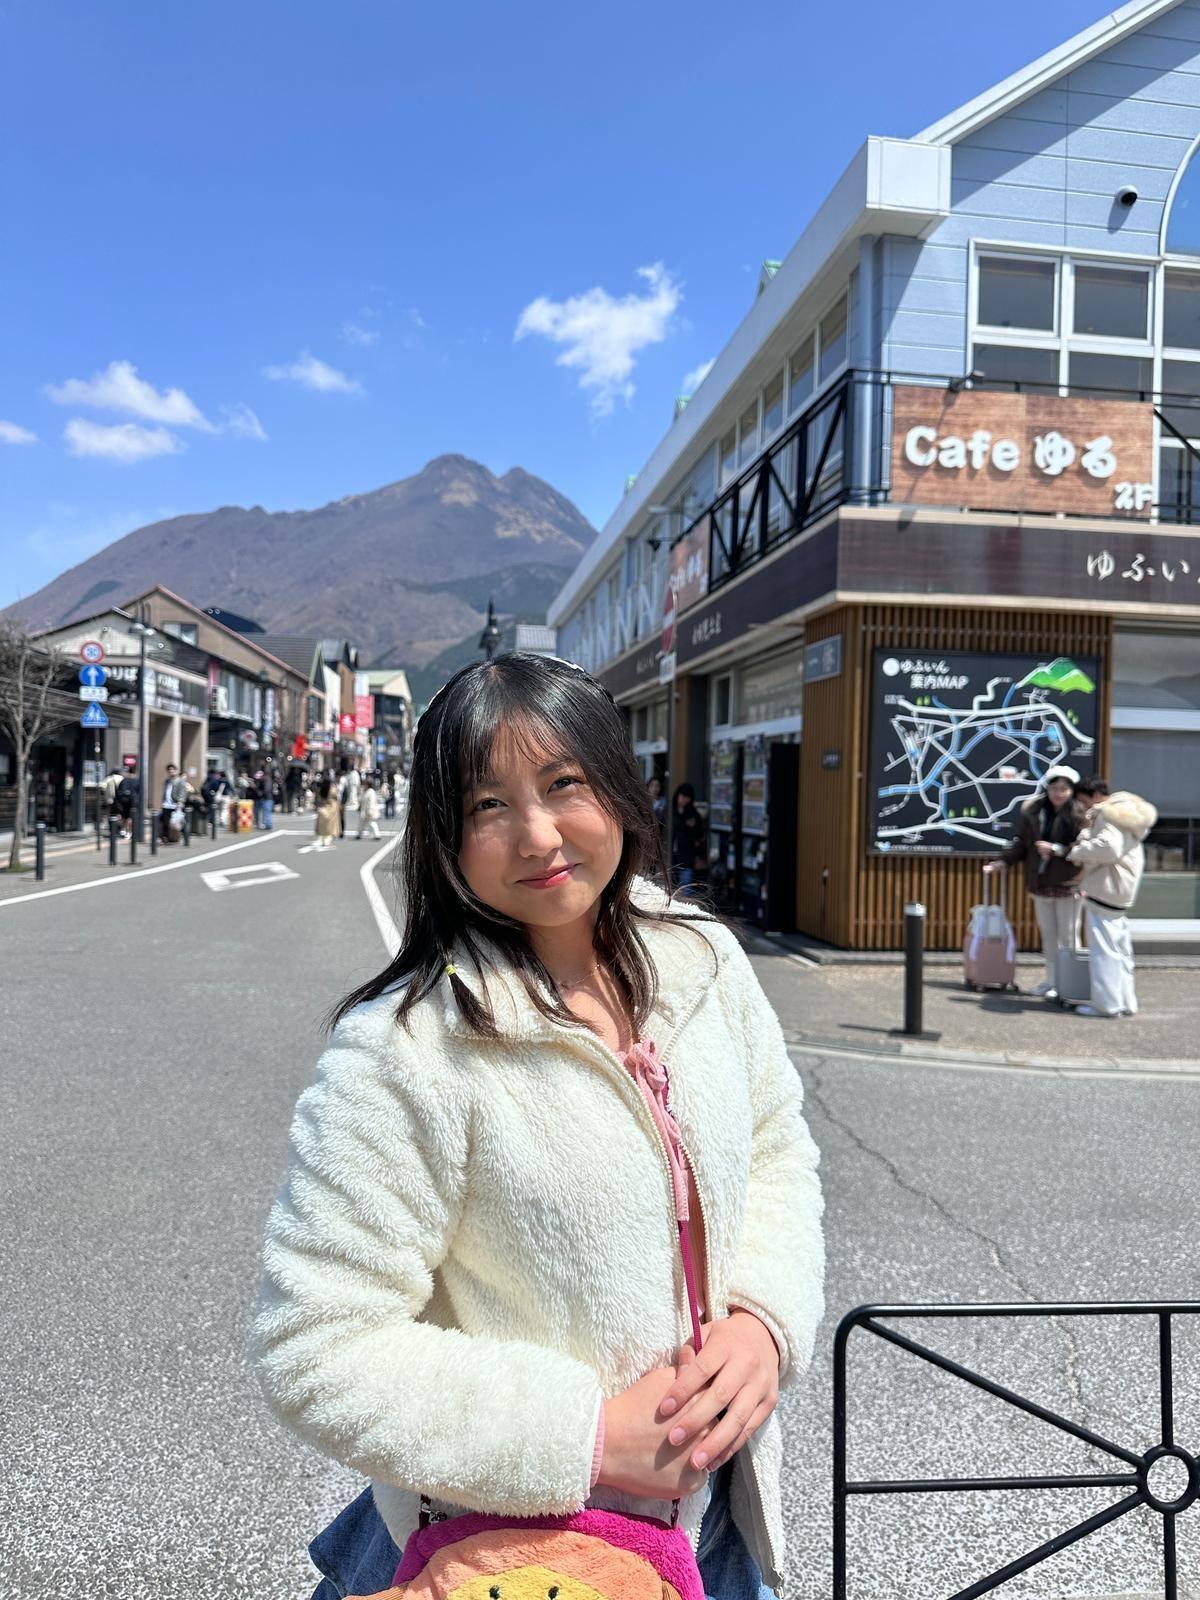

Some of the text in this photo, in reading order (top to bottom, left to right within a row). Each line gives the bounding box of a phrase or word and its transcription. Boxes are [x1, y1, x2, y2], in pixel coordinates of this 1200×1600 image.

[904, 425, 1118, 479] Cafe ゆる
[1114, 481, 1154, 511] 2F
[1086, 550, 1200, 583] ゆふい
[900, 658, 950, 674] ゆふいん
[910, 673, 969, 690] 案内MAP
